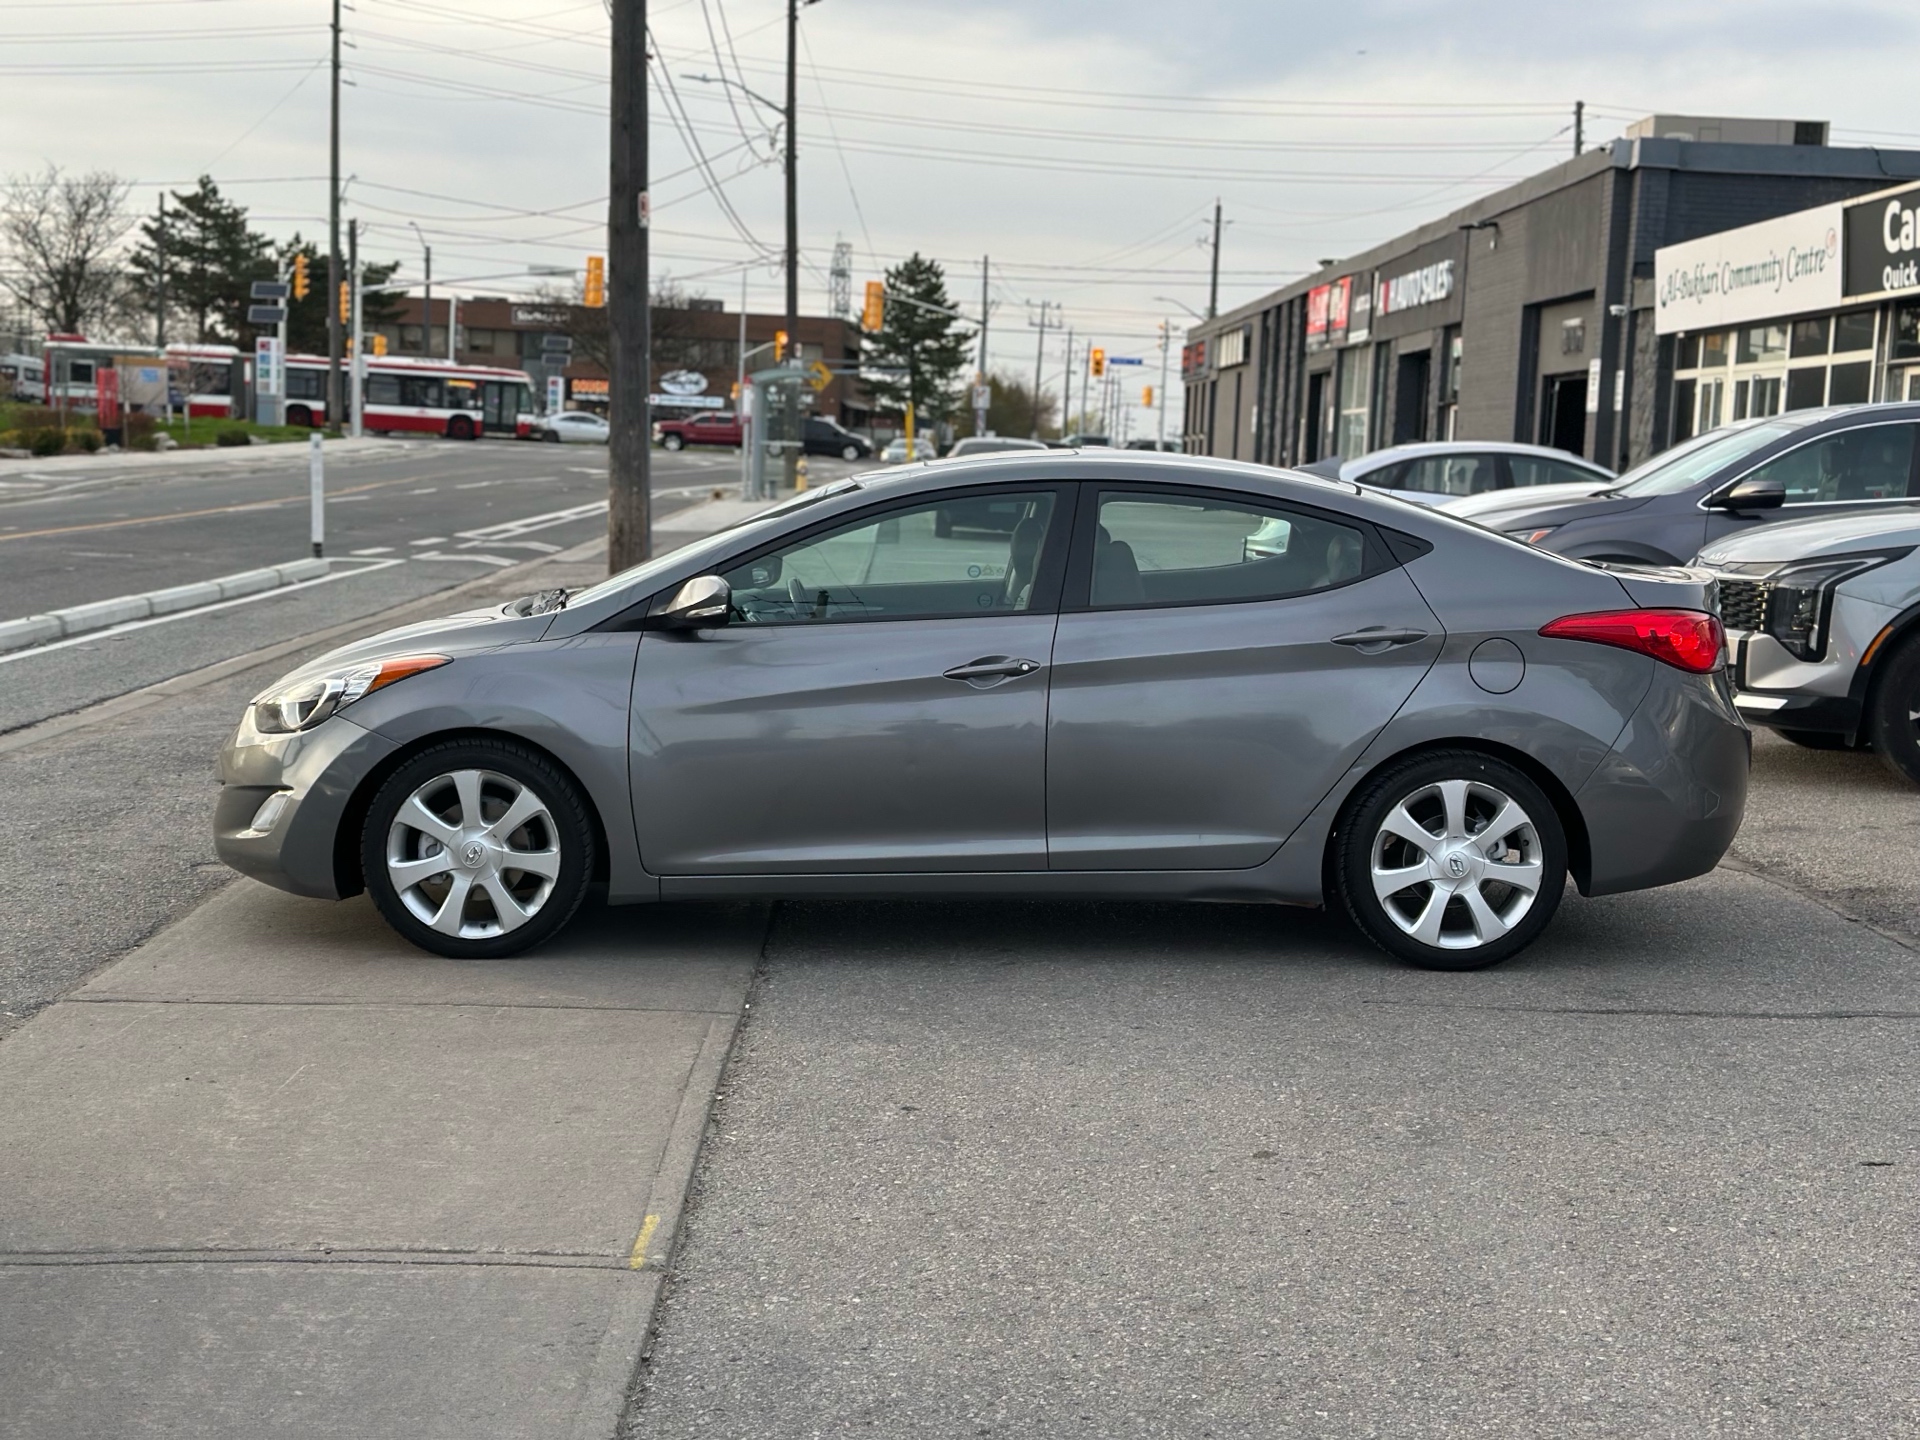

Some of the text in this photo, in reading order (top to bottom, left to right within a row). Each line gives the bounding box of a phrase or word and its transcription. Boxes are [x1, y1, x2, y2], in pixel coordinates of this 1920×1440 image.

[1421, 260, 1454, 305] SALES
[1721, 250, 1784, 293] Community
[1786, 247, 1826, 283] Centre
[1882, 259, 1918, 291] Quick
